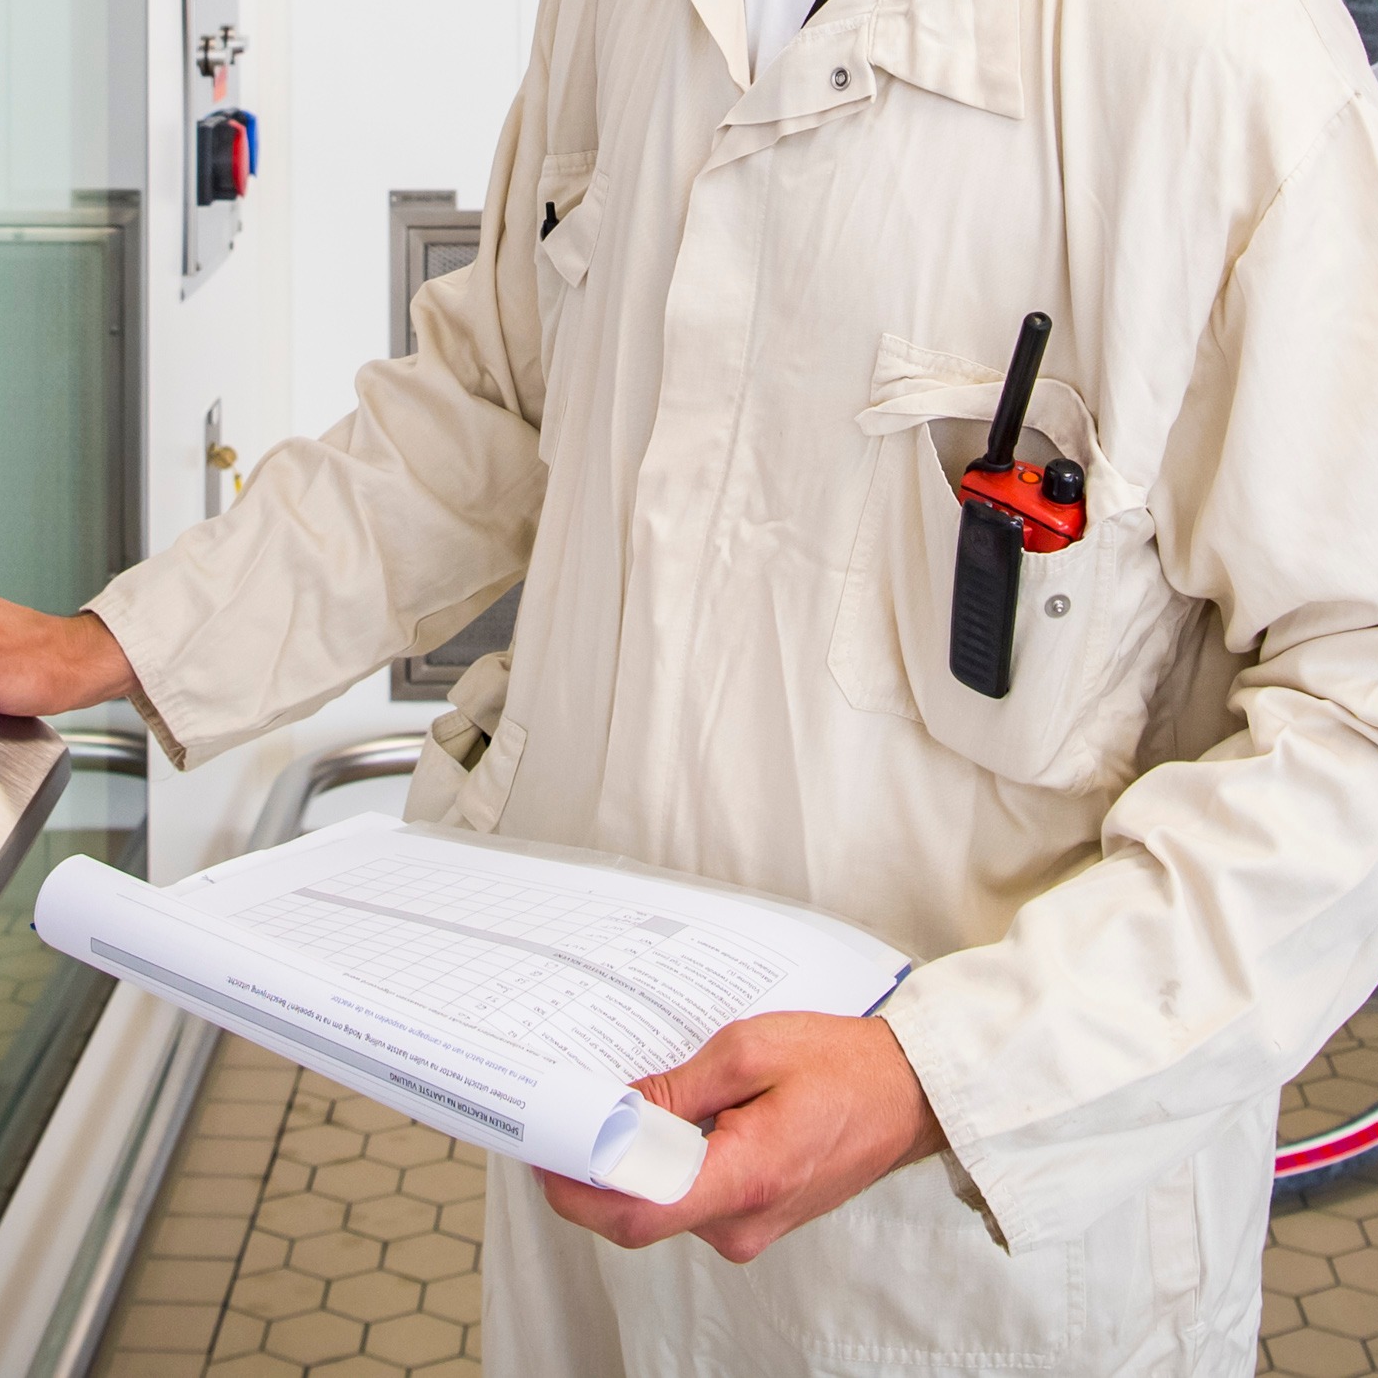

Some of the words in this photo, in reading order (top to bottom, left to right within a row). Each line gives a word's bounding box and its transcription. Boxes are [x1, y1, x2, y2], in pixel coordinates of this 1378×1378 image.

[249, 984, 288, 1008] Beschrijving
[285, 999, 316, 1020] spoelen?
[312, 1012, 323, 1022] te
[353, 1004, 364, 1014] de
[363, 1007, 375, 1018] via
[321, 1016, 332, 1025] na
[330, 1020, 343, 1030] om
[373, 1010, 408, 1033] naspoelen
[670, 1013, 685, 1026] van
[341, 1023, 364, 1040] Nodig
[406, 1024, 443, 1047] campagne
[384, 1042, 409, 1060] laatste
[440, 1041, 452, 1051] de
[450, 1045, 465, 1056] van
[407, 1052, 430, 1069] vullen
[428, 1061, 439, 1071] na
[463, 1050, 485, 1066] batch
[638, 1053, 662, 1074] olume
[437, 1065, 464, 1082] reactor
[483, 1059, 508, 1075] laatste
[507, 1069, 519, 1079] na
[387, 1071, 418, 1090] VULLING
[462, 1075, 489, 1094] uitzicht
[516, 1072, 538, 1088] Enkel
[417, 1084, 447, 1103] LAATSTE
[488, 1086, 527, 1110] Controleer
[455, 1100, 489, 1122] REACTOR
[487, 1114, 520, 1135] SPOELEN
